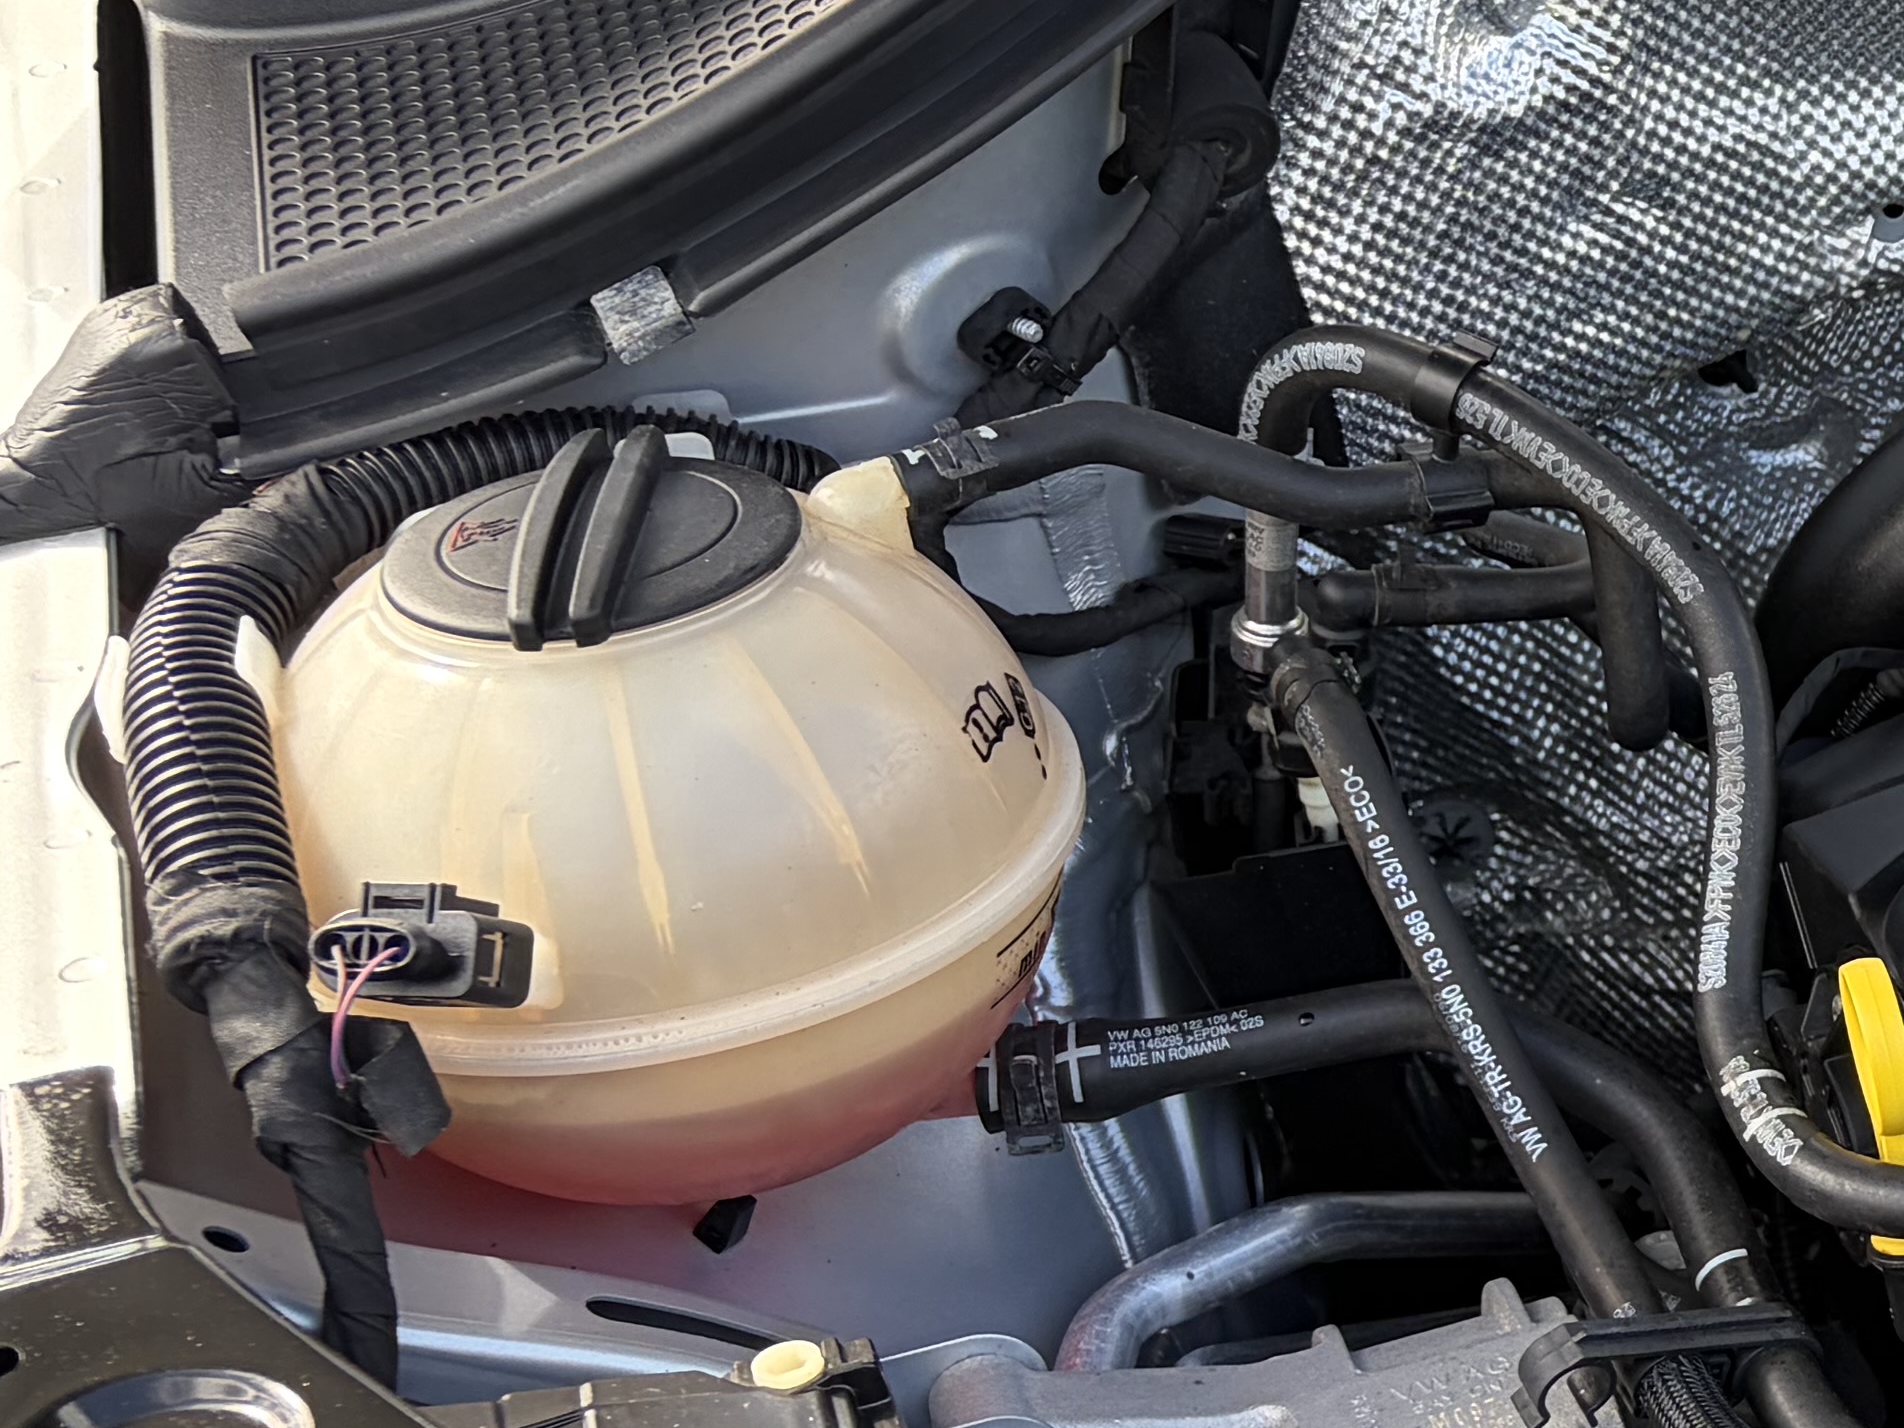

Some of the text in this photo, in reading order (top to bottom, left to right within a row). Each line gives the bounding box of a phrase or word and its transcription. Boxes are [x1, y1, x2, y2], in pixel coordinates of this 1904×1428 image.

[1368, 834, 1418, 909] E-33/16
[1404, 910, 1435, 947] 366
[1428, 947, 1453, 981] 133
[1108, 1029, 1130, 1042] VW
[1132, 1027, 1152, 1039] AG
[1182, 1018, 1204, 1032] 122
[1206, 1014, 1228, 1027] 109
[1108, 1039, 1137, 1053] PXR
[1109, 1036, 1232, 1069] MADE IN ROMANIA
[1441, 984, 1530, 1124] AG-TR-KRS-5N0
[1520, 1125, 1548, 1163] VW
